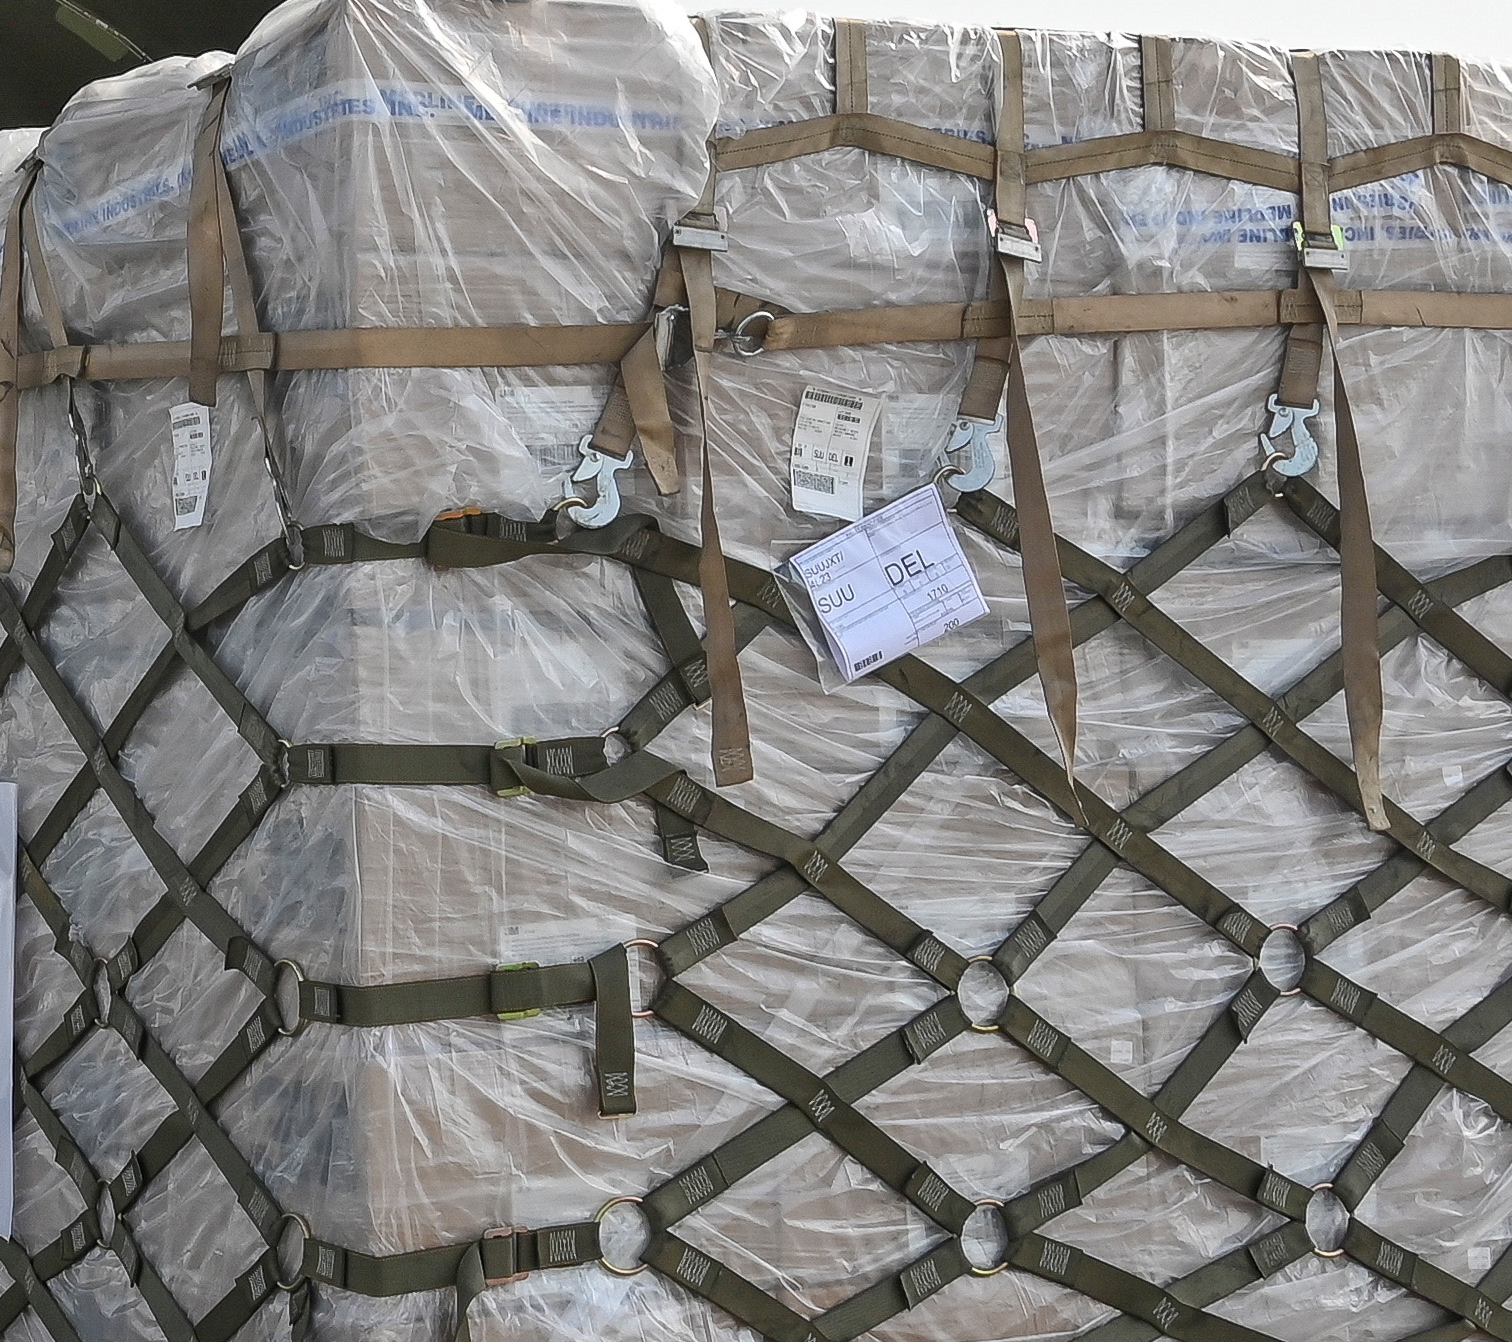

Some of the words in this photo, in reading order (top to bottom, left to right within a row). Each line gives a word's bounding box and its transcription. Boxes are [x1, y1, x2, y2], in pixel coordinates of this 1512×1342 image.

[884, 549, 935, 587] DEL
[818, 583, 855, 614] SUU
[926, 583, 949, 602] 1710
